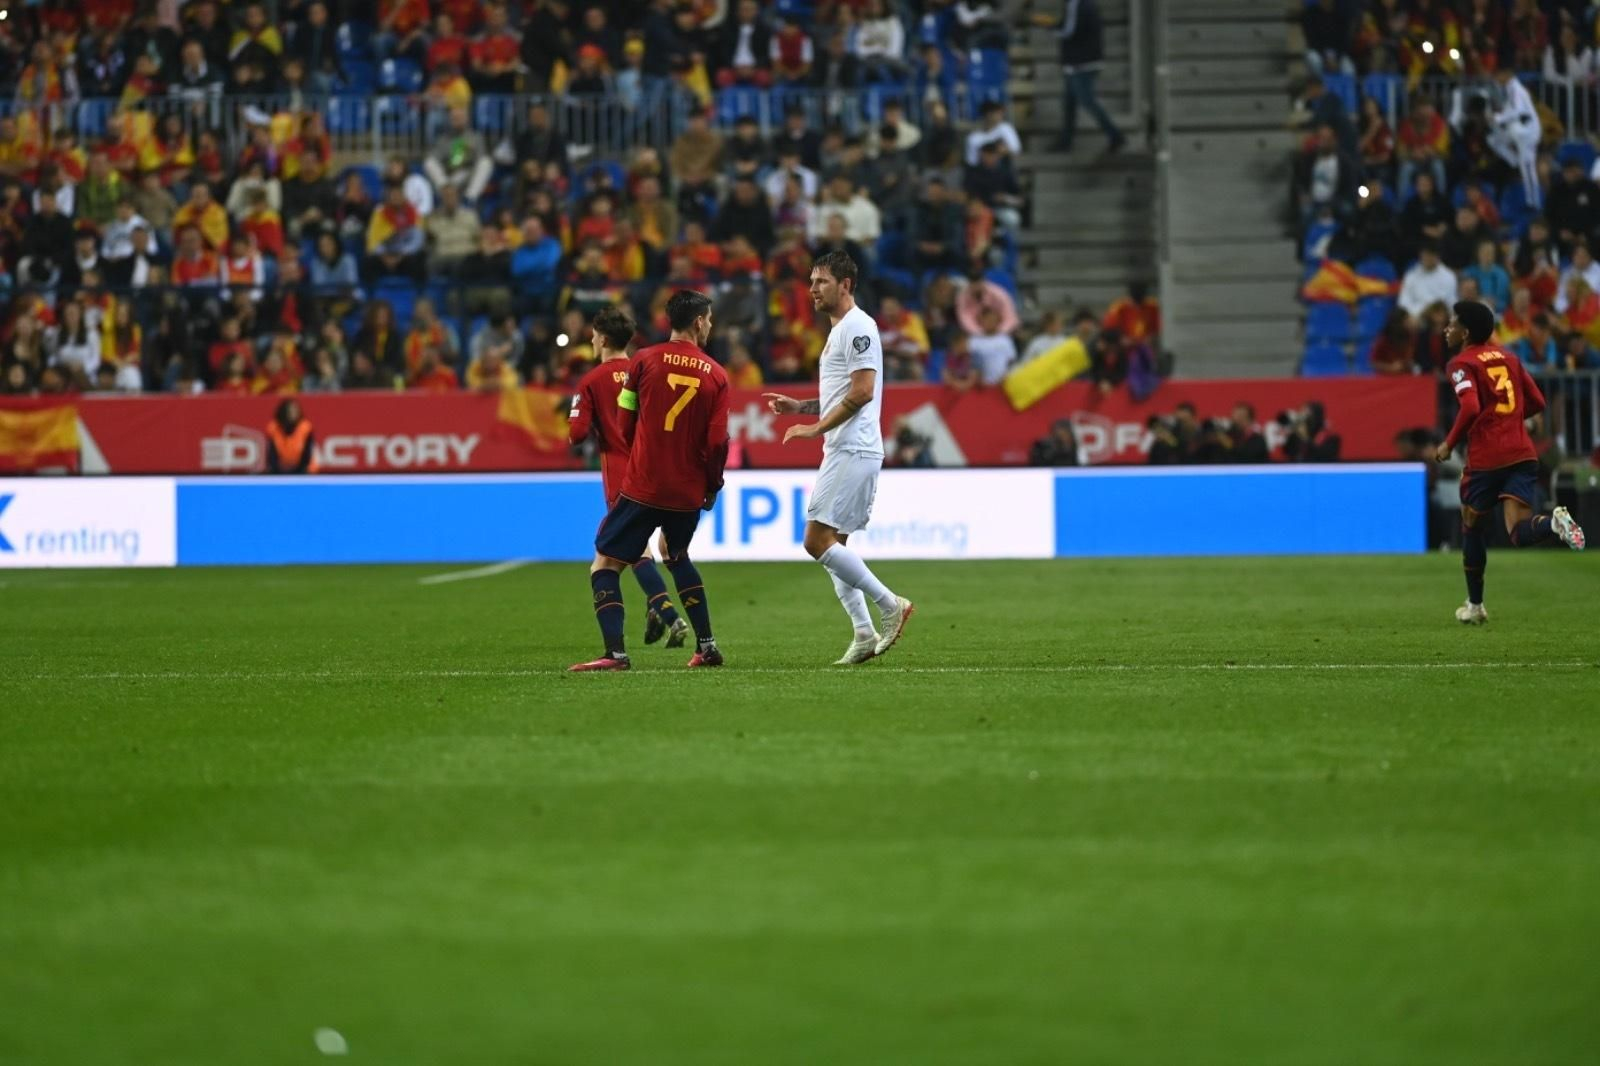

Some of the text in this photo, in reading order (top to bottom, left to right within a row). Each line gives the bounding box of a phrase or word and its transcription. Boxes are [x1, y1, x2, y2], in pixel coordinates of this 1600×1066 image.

[663, 352, 713, 375] MORATA
[664, 372, 700, 432] 7
[1487, 365, 1515, 414] 3
[25, 527, 140, 563] renting
